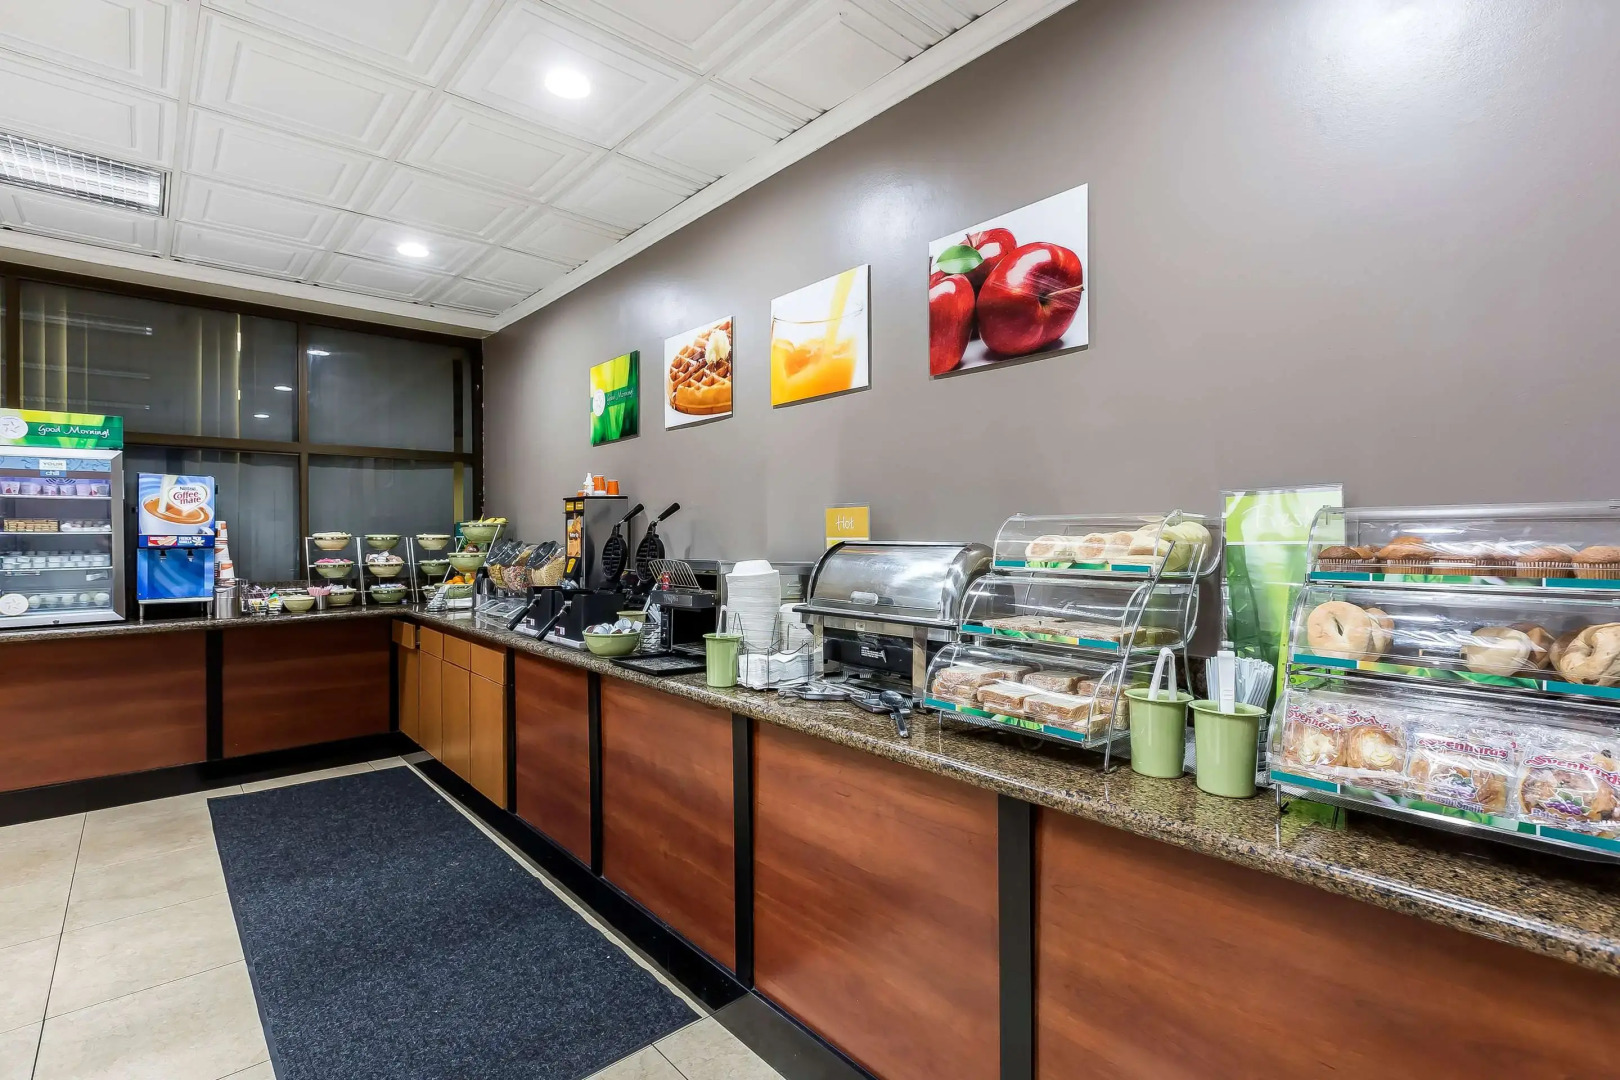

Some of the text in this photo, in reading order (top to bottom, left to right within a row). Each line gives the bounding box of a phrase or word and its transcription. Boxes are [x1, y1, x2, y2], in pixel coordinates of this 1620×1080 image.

[38, 424, 110, 438] Good Morning!
[180, 497, 201, 505] mate
[835, 514, 855, 531] Hot
